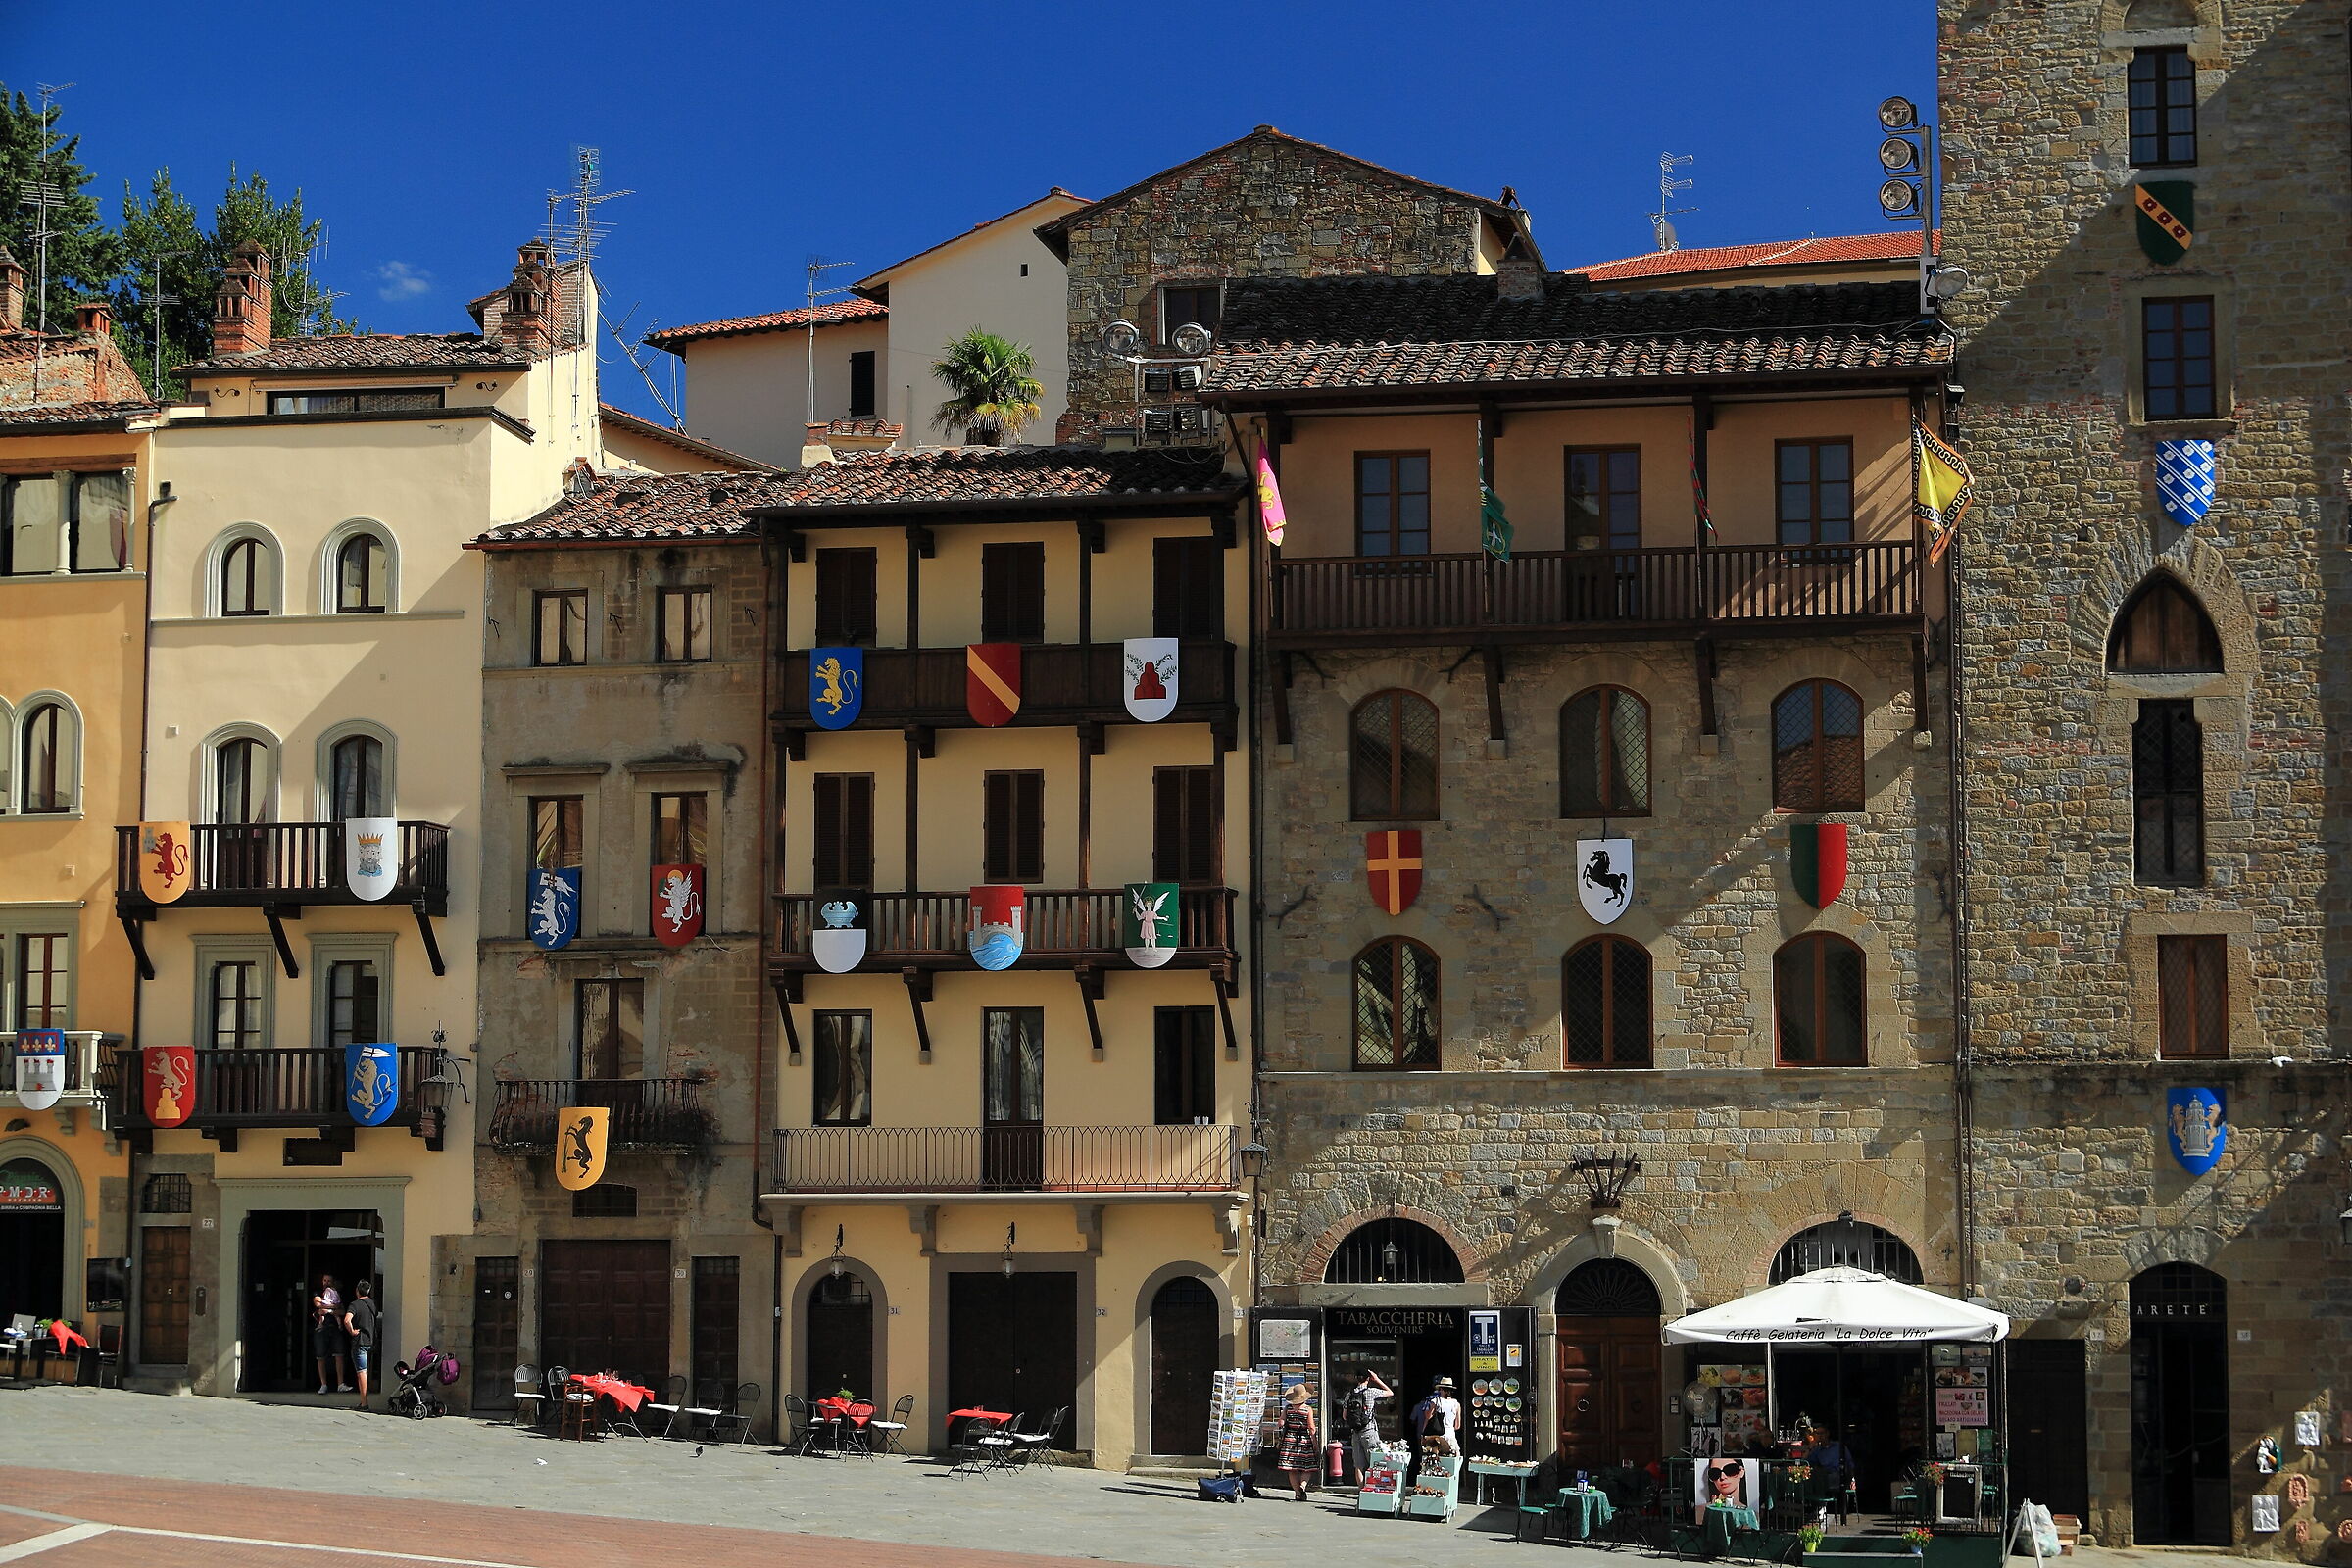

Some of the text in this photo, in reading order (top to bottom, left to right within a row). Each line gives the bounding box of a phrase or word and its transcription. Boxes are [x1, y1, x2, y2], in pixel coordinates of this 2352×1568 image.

[1336, 1311, 1454, 1325] TABACCHERIA
[1366, 1325, 1424, 1334] SOUVENIRS
[1475, 1317, 1494, 1344] T
[1726, 1329, 1760, 1340] Caffè
[1768, 1328, 1825, 1340] Gelateria
[1859, 1328, 1893, 1339] Dolce
